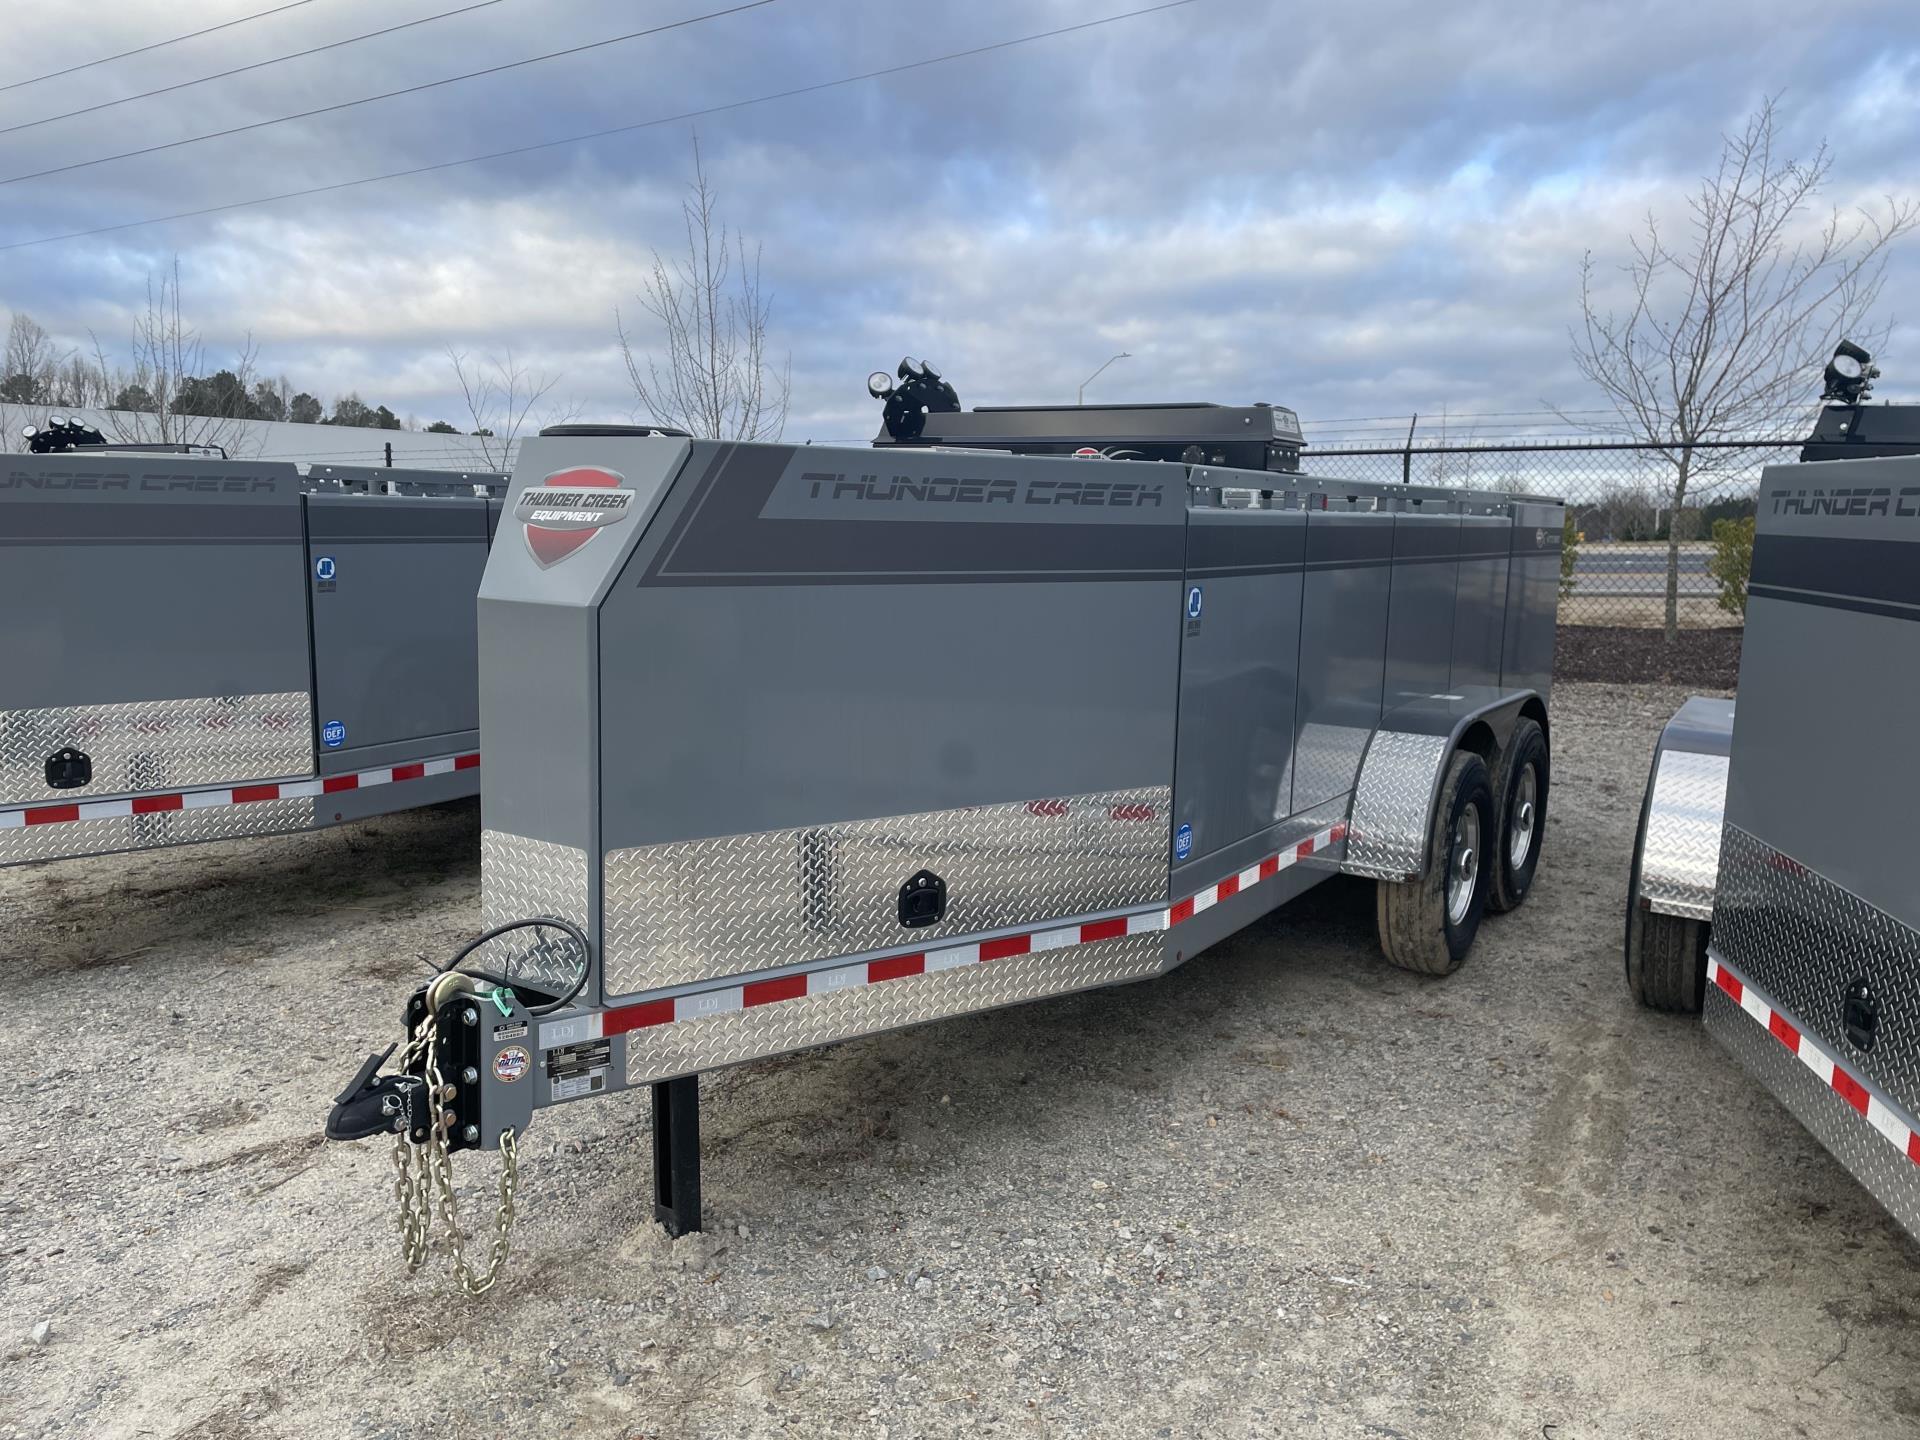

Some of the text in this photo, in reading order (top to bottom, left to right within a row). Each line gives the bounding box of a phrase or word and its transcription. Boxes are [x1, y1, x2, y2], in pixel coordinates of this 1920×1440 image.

[139, 474, 276, 493] CREEK
[800, 472, 1164, 507] THUNDER CREEK
[520, 492, 631, 509] THUNDER CREEK
[1771, 487, 1891, 516] THUNDER
[530, 510, 605, 522] EQUIPMENT
[326, 729, 341, 739] DEF
[1178, 836, 1190, 849] DEF
[699, 997, 718, 1009] LDJ
[552, 1025, 574, 1039] LDJ
